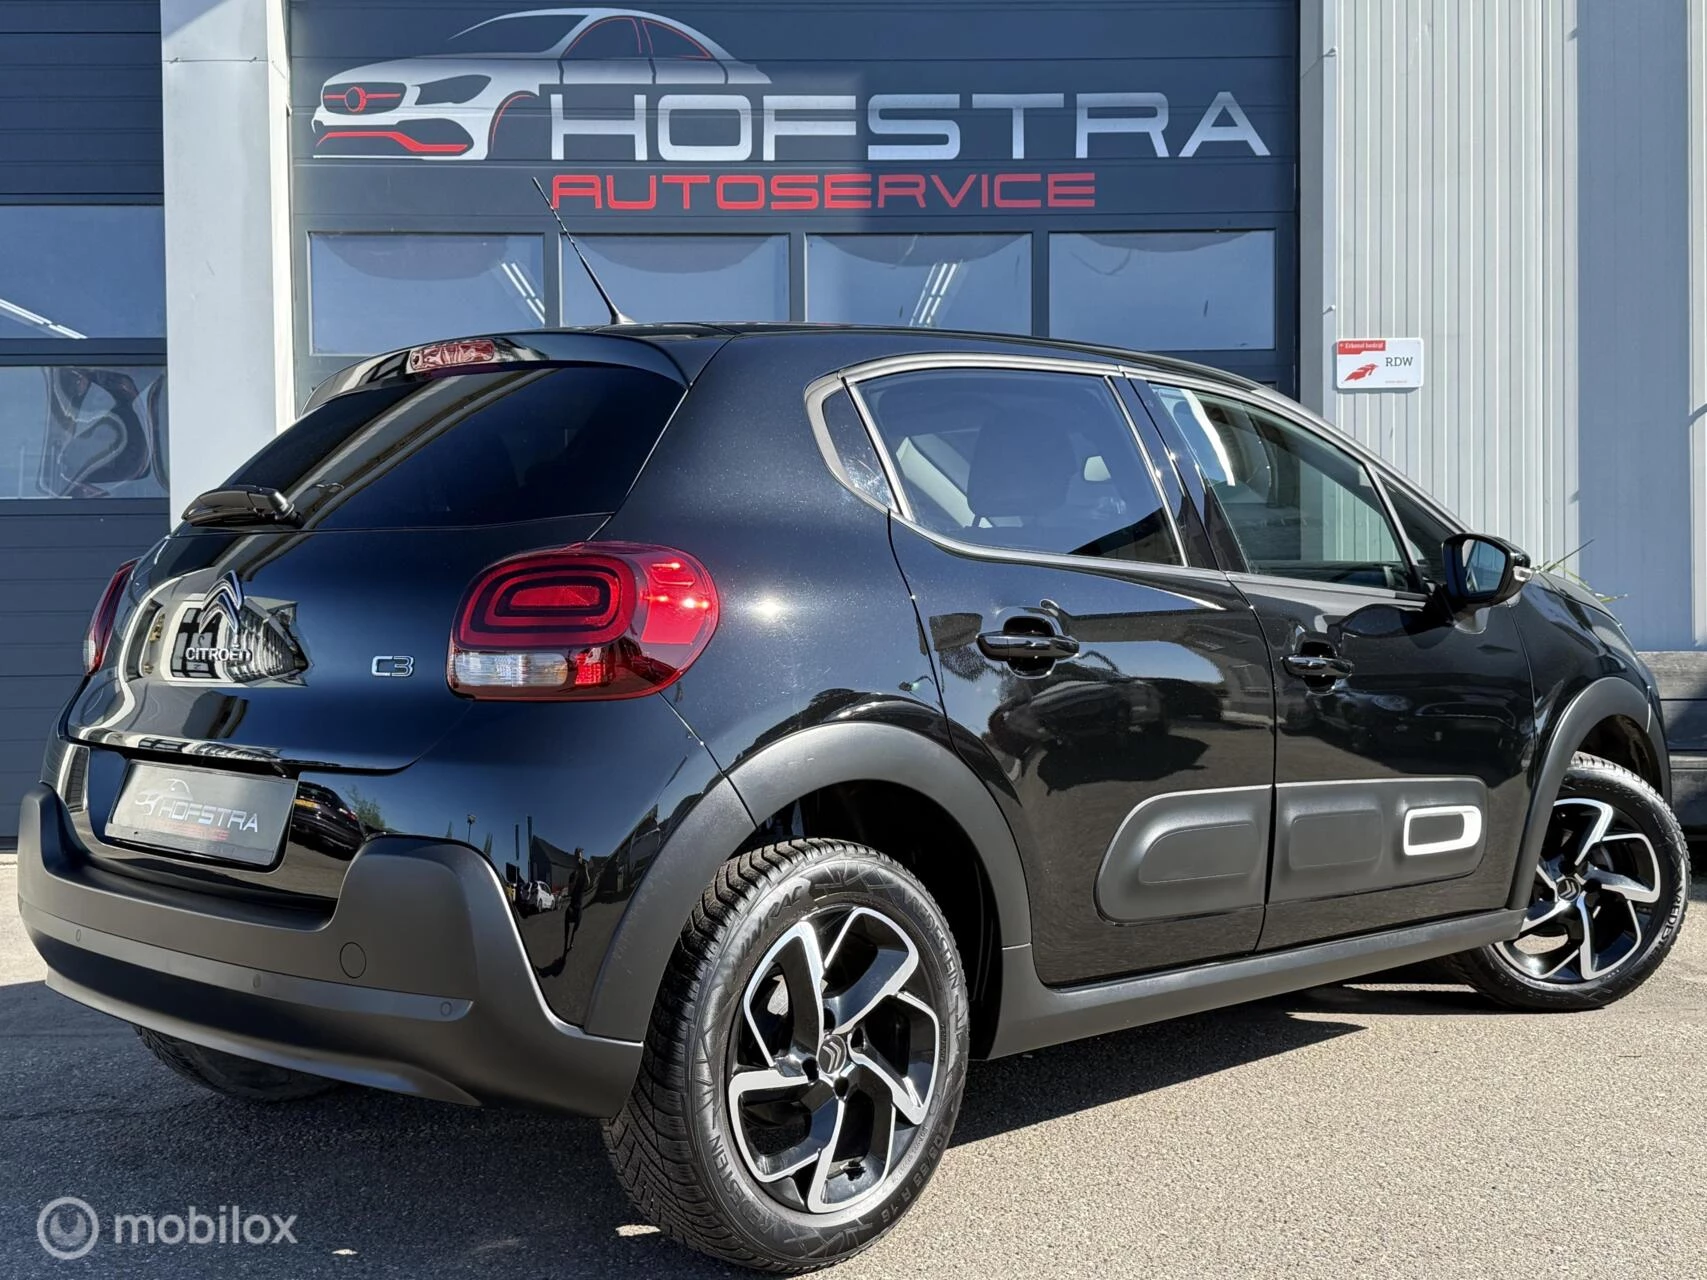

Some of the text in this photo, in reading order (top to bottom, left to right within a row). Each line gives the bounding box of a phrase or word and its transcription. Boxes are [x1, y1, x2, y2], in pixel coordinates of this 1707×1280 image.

[550, 92, 1271, 162] HOFSTRA
[552, 172, 1096, 210] AUTOSERVICE
[1385, 357, 1413, 367] RDW
[371, 655, 414, 677] C3
[159, 800, 258, 833] HOFSTRA
[708, 1134, 776, 1234] VREDESTEIN
